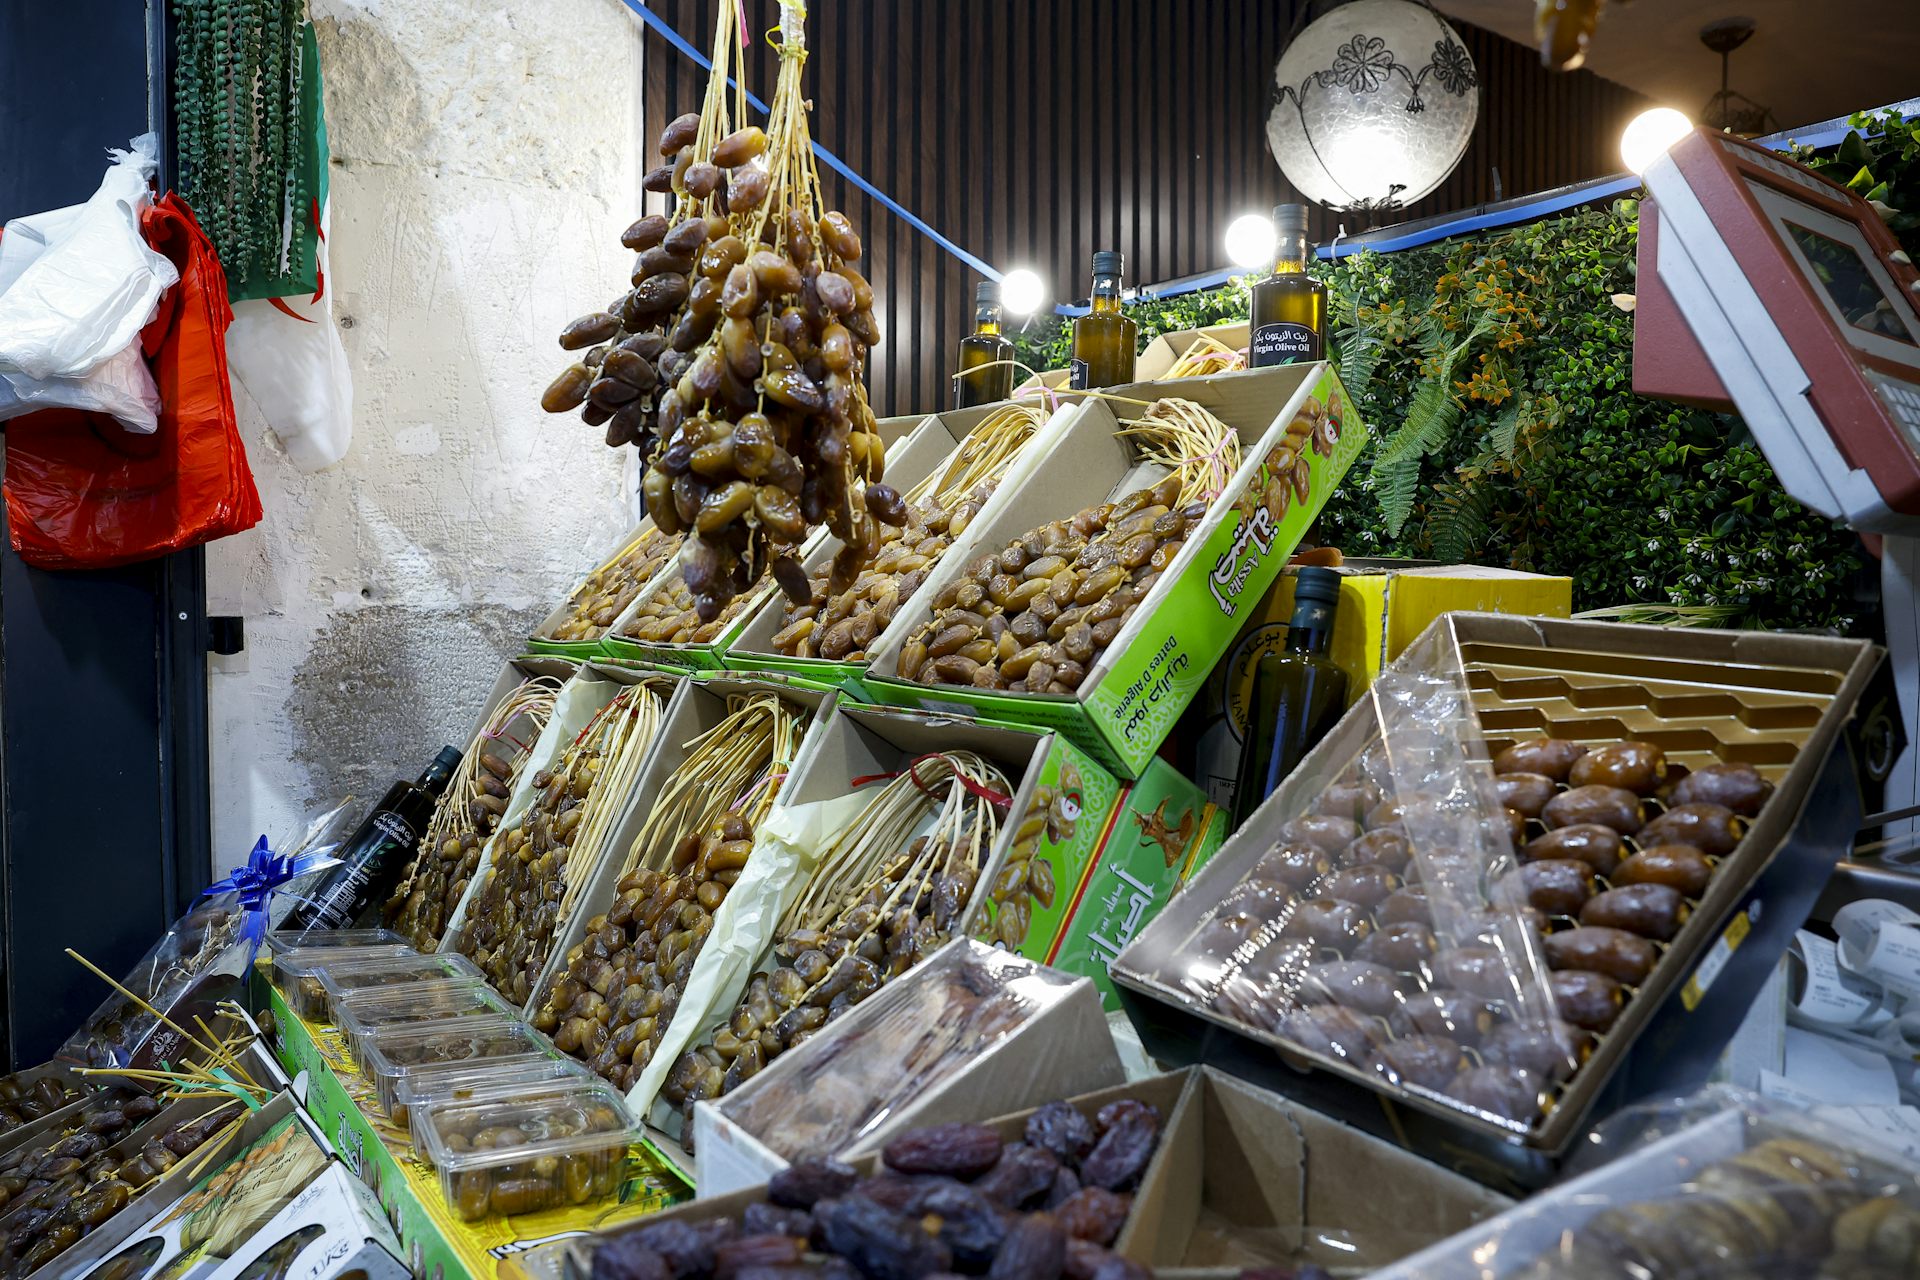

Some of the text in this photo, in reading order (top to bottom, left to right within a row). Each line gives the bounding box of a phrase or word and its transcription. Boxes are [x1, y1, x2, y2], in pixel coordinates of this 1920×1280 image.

[1265, 331, 1292, 342] الزيتون
[1293, 332, 1308, 342] زيت
[1254, 343, 1310, 354] Virgin Olive Oil
[1227, 548, 1259, 597] Assila
[1114, 635, 1177, 719] Dattes D'Algerie
[1124, 653, 1189, 742] تمور جزائرية
[388, 829, 403, 843] Olive
[401, 839, 411, 848] Oil
